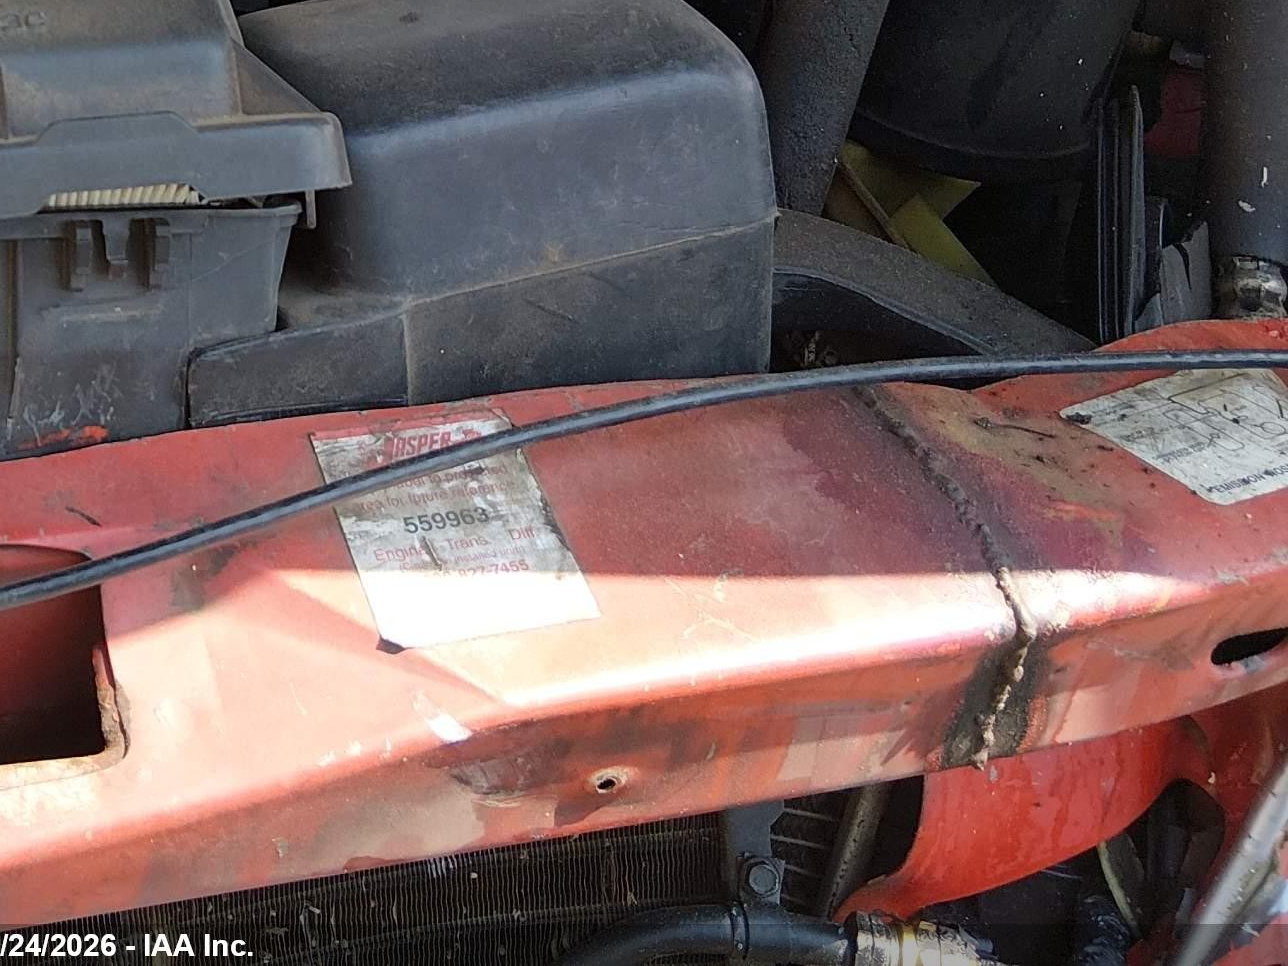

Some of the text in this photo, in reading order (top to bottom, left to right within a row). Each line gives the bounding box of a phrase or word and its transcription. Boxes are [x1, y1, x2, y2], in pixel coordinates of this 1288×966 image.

[386, 495, 404, 508] for
[408, 489, 449, 506] future
[402, 506, 491, 534] 559963
